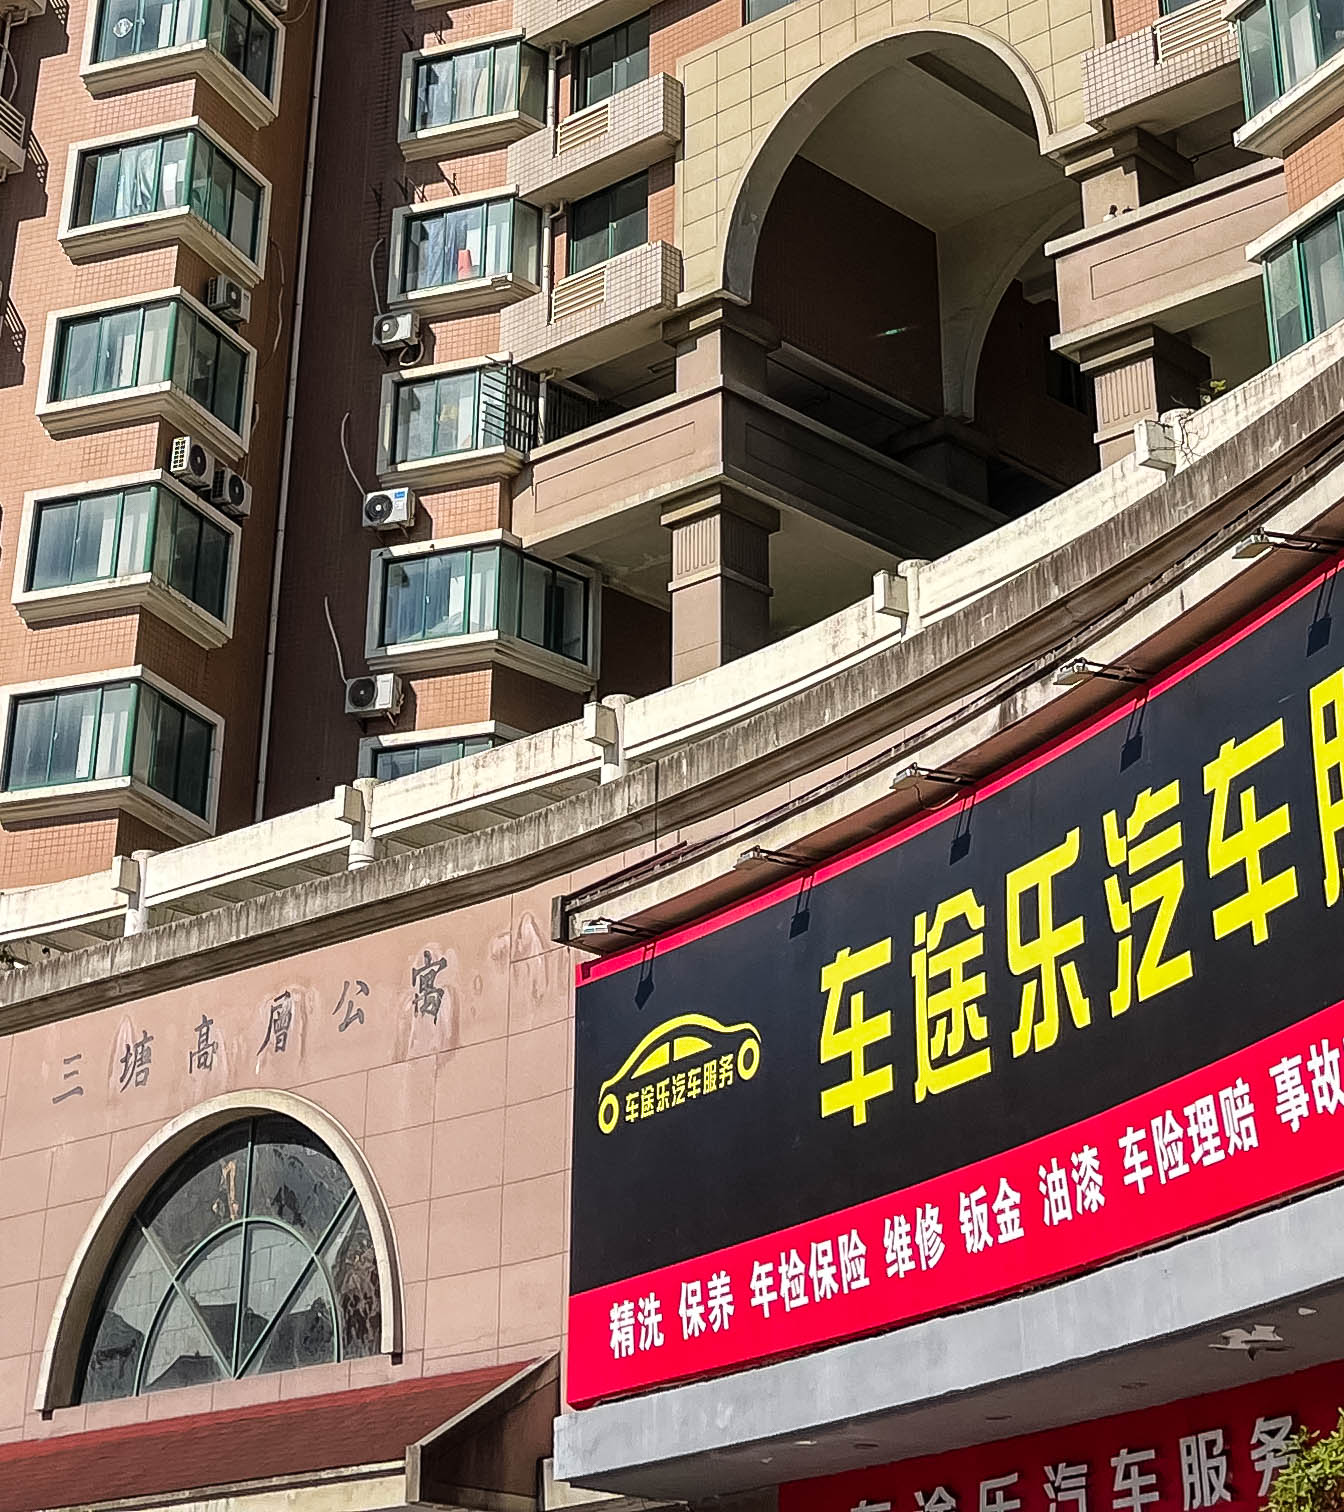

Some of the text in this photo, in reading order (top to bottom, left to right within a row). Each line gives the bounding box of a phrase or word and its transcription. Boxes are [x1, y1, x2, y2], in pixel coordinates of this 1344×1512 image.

[625, 1053, 734, 1123] 车途乐汽车服务
[609, 1292, 664, 1358] 精洗
[678, 1270, 735, 1339] 保养
[750, 1229, 870, 1318] 年检保险
[883, 1203, 946, 1278] 维修
[959, 1177, 1025, 1254] 钣金
[1038, 1145, 1106, 1226] 油漆
[1118, 1078, 1259, 1194] 车险理赔
[851, 1416, 1294, 1512] 乐汽车服务
